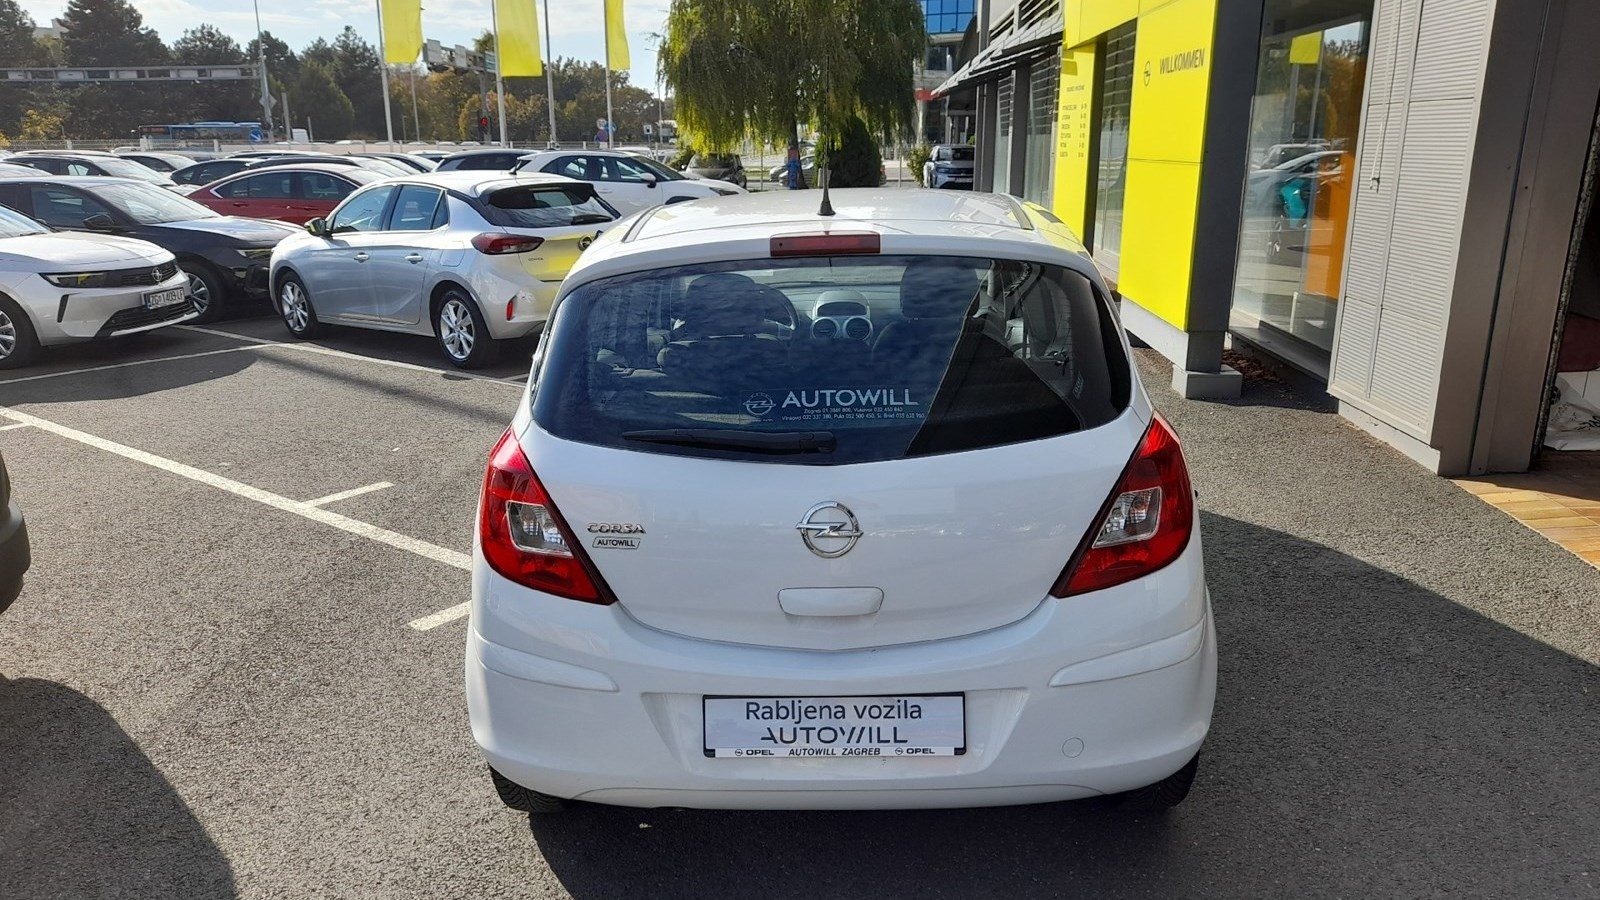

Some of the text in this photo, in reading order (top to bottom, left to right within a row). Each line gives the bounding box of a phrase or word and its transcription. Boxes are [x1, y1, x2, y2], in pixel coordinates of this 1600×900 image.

[1159, 48, 1205, 74] WILLKOMMEN
[781, 389, 918, 408] AUTOWILL
[587, 523, 647, 534] CORSA
[597, 539, 636, 547] AUTOWILL
[746, 699, 922, 724] Rabljena vozila
[760, 726, 908, 744] AUTOWILL
[788, 747, 881, 756] AUTOWILL ZAGREB
